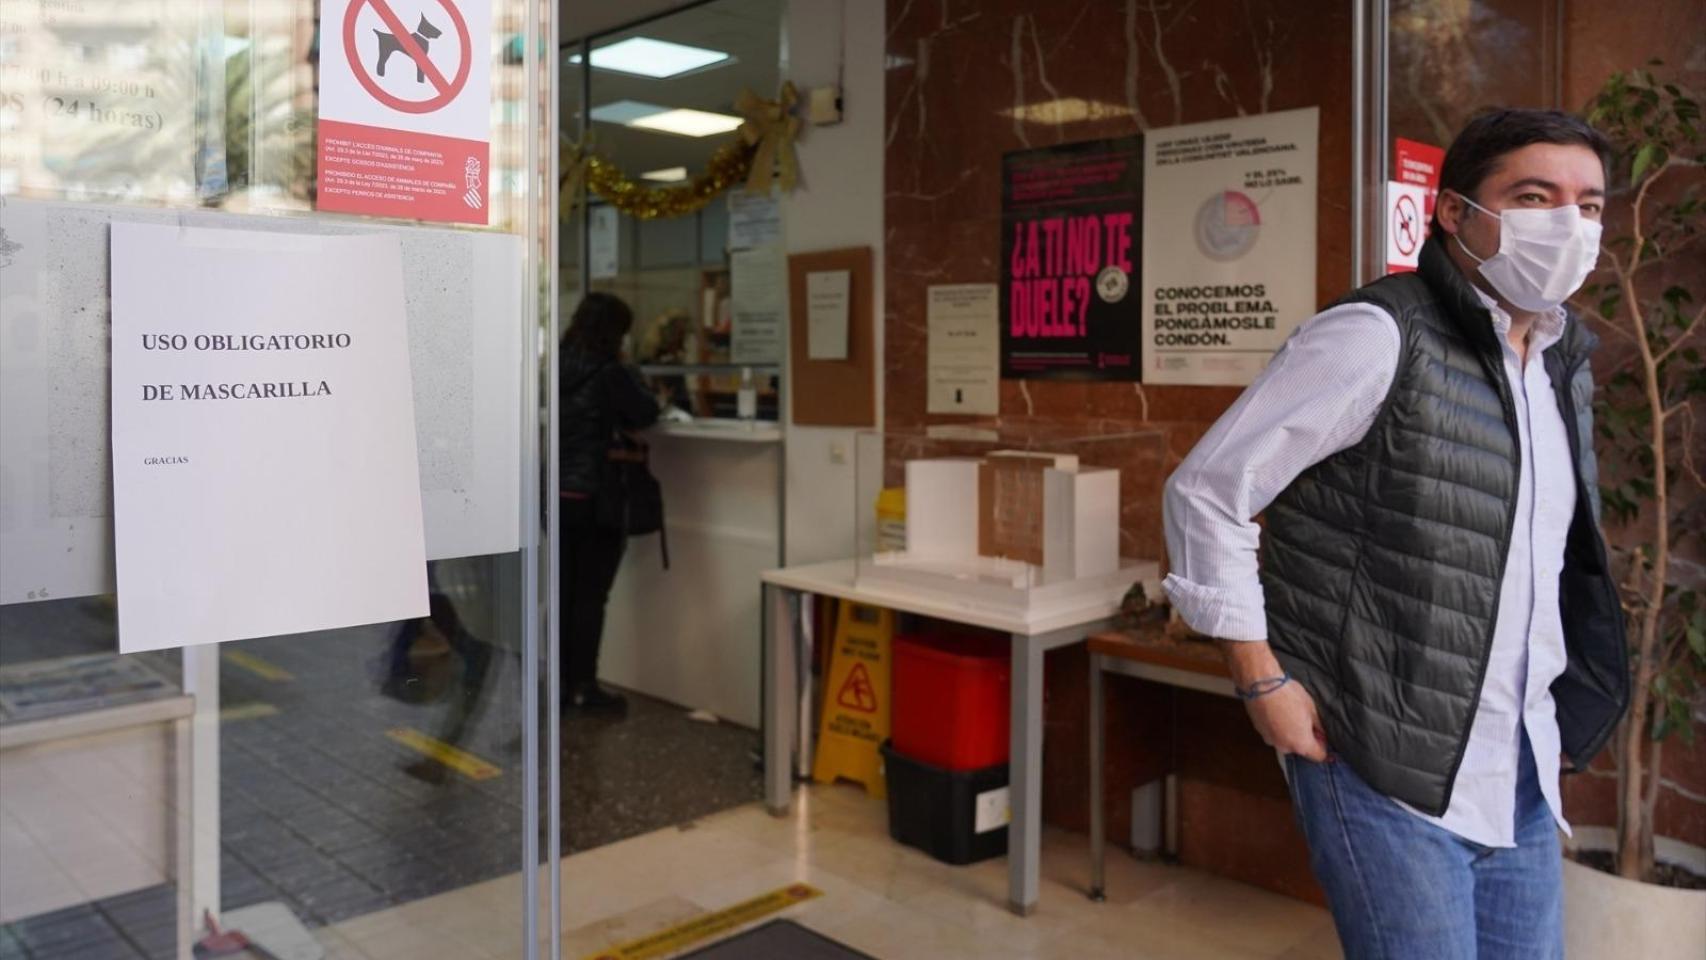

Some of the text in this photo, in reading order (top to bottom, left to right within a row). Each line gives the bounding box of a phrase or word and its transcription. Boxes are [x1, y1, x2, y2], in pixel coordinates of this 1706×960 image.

[89, 101, 163, 132] horas)
[1011, 214, 1132, 278] ¿A TI NO TE
[1155, 285, 1265, 300] CONOCEMOS
[1010, 277, 1090, 337] DUELE?
[1155, 301, 1278, 315] EL PROBLEMA.
[1155, 315, 1275, 330] PONGÁMOSLE
[142, 333, 351, 350] USO OBLIGATORIO
[1155, 332, 1231, 346] CONDÓN.
[142, 380, 332, 400] DE MASCARILLA
[144, 456, 189, 466] GRACIAS
